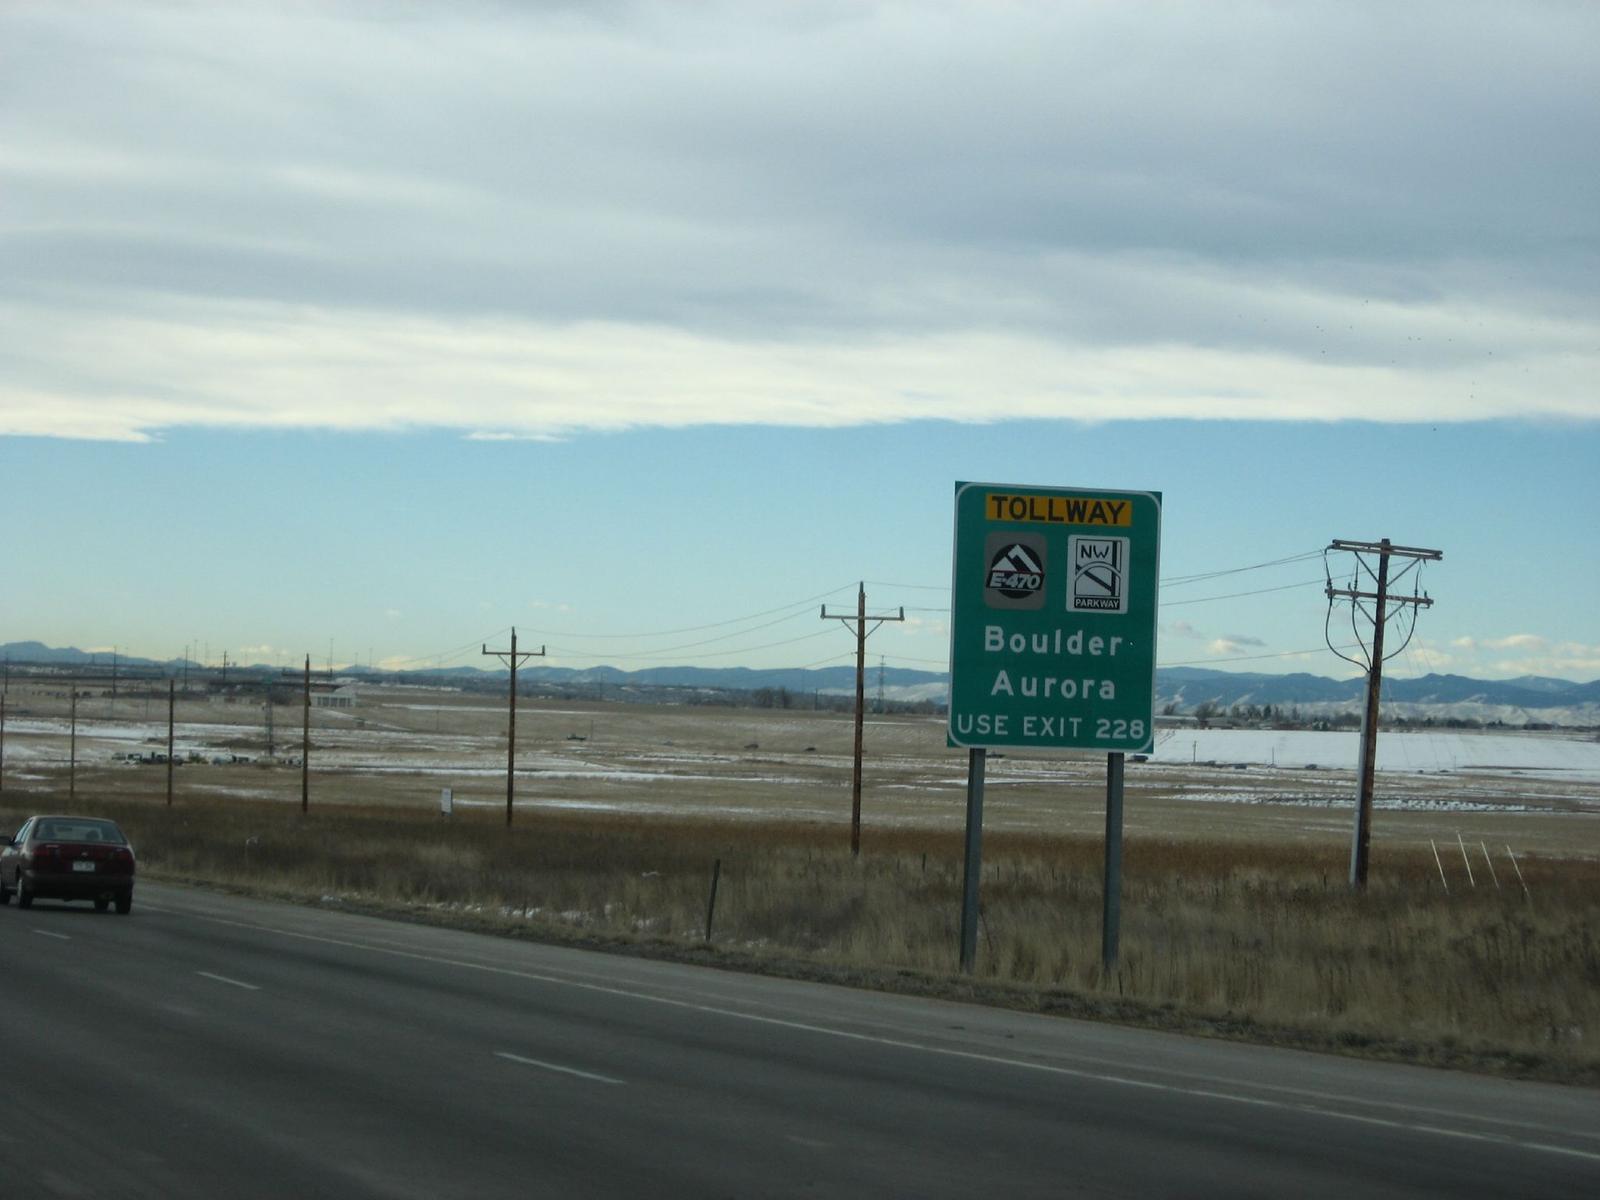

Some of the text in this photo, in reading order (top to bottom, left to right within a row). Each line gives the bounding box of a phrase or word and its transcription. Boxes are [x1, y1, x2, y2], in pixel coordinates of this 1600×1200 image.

[992, 496, 1126, 525] TOLLWAY
[1080, 544, 1110, 559] NW
[989, 571, 1041, 590] E-470
[1075, 598, 1120, 609] PARKWAY
[984, 625, 1123, 656] Boulder
[991, 669, 1116, 699] Aurora
[957, 713, 1145, 740] USE EXIT 228
